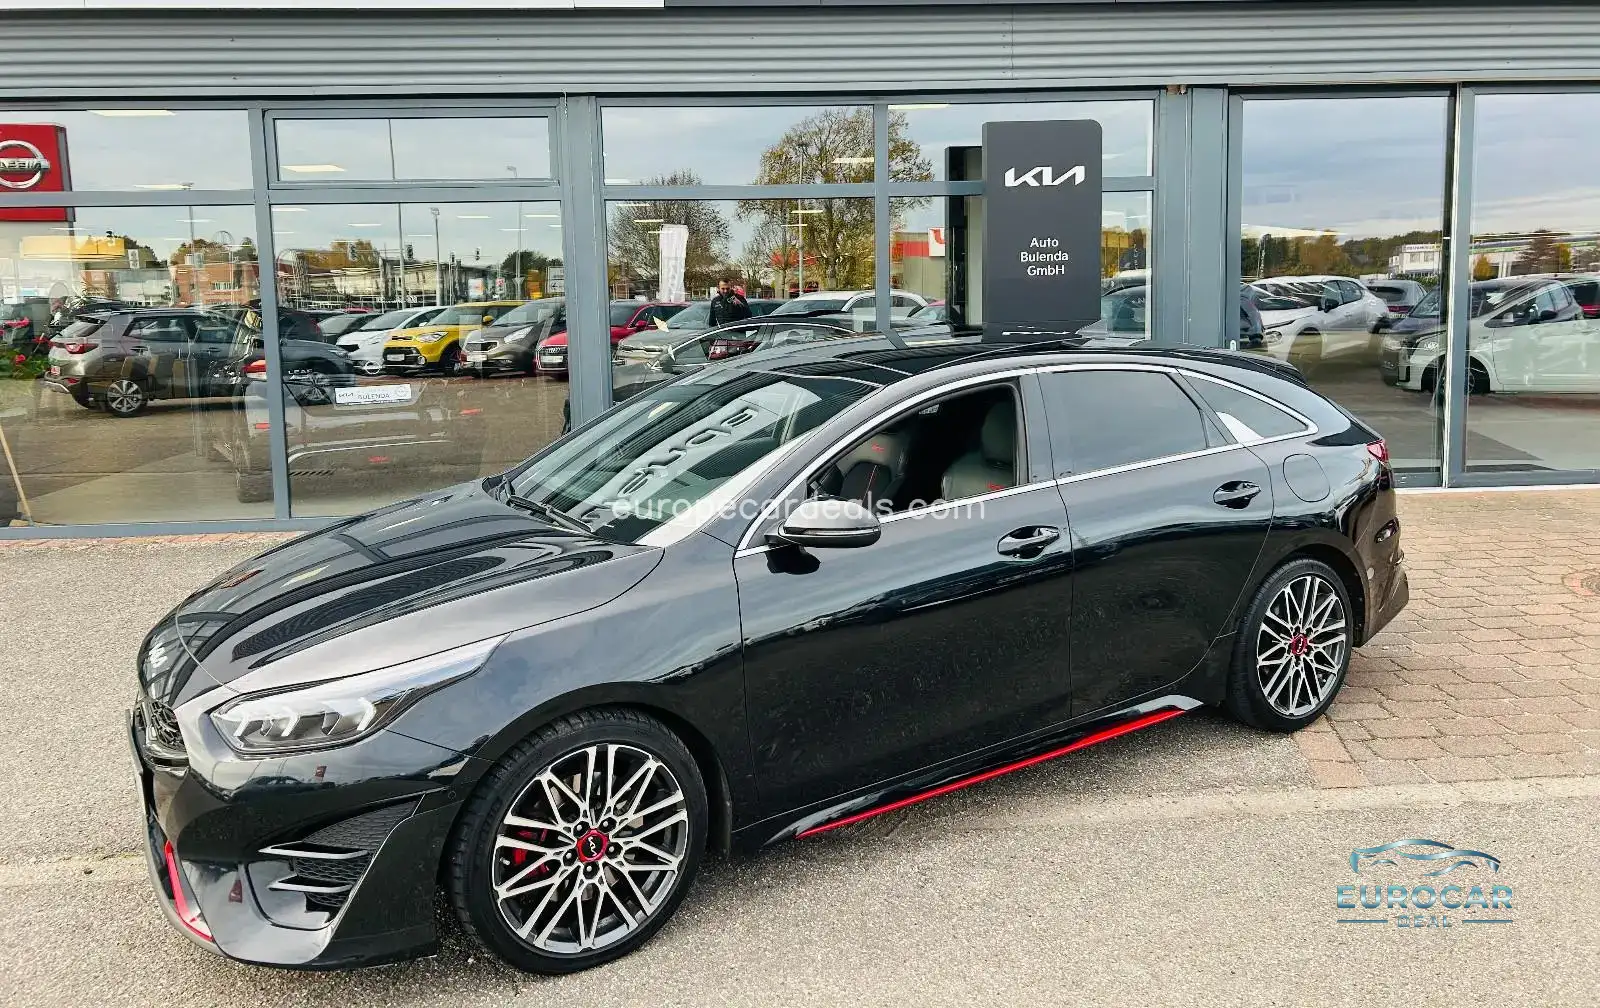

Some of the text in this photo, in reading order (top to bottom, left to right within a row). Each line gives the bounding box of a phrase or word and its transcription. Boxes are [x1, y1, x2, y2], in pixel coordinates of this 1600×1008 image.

[1004, 165, 1086, 187] KIA
[1029, 237, 1059, 247] Auto
[1020, 251, 1069, 262] Bulenda
[1027, 265, 1065, 275] GmbH
